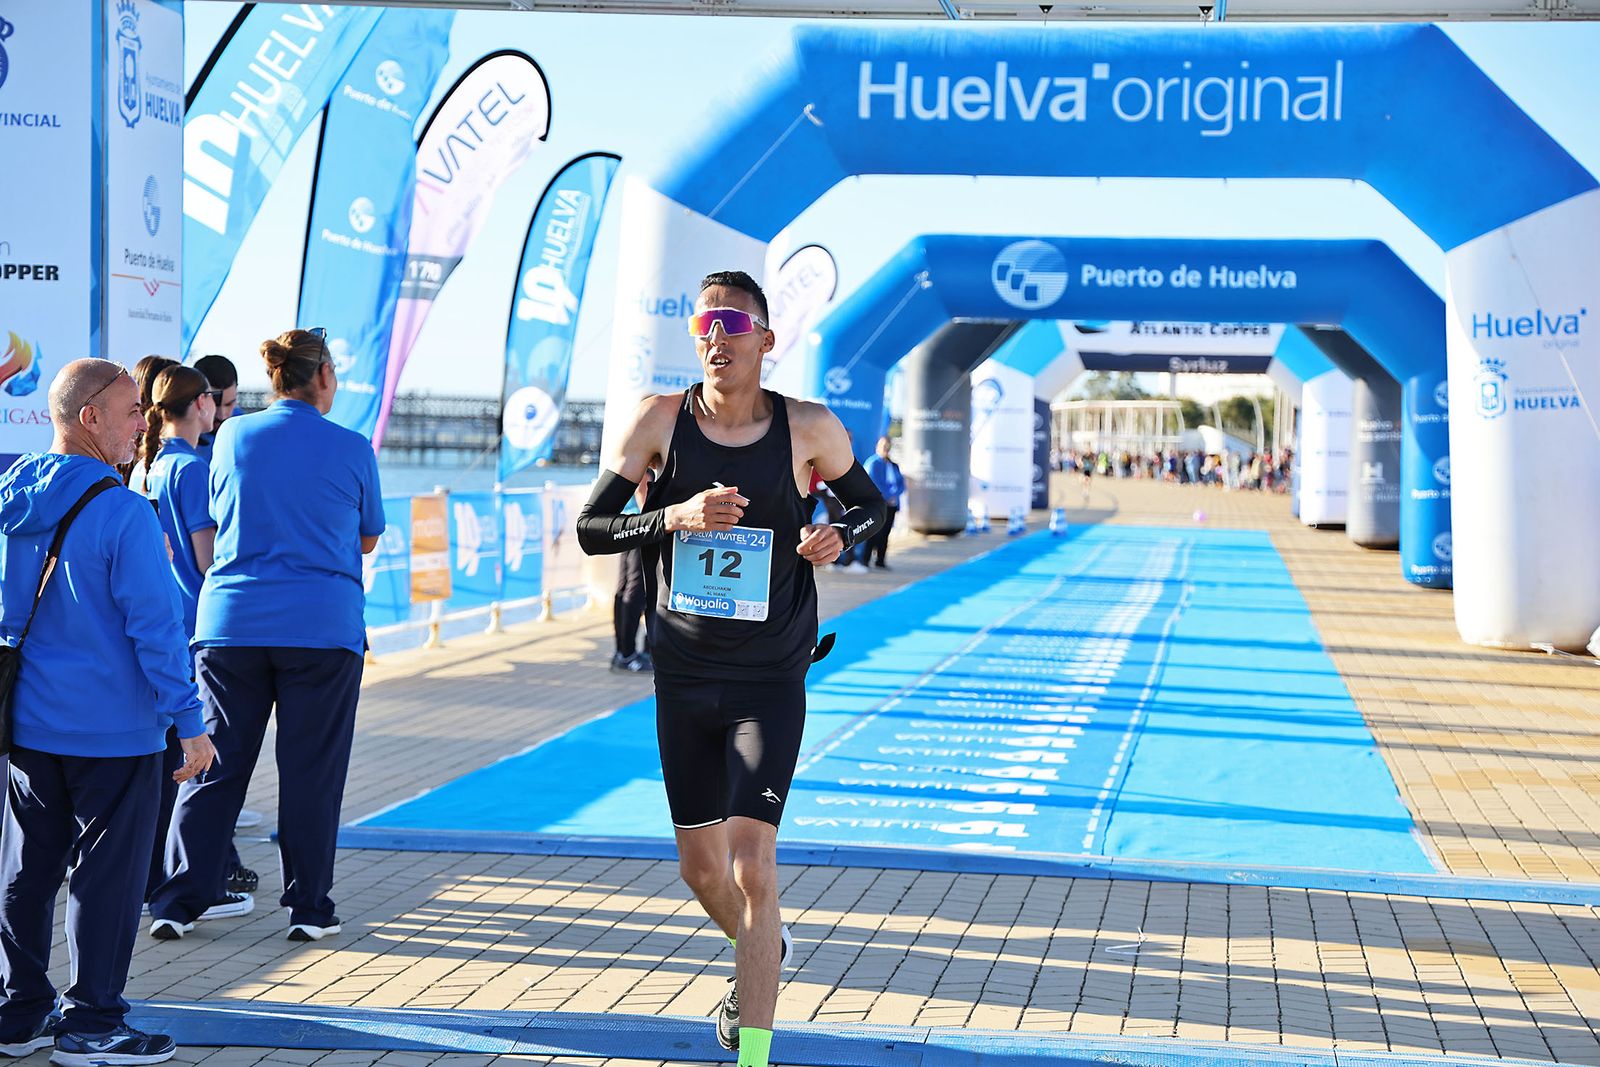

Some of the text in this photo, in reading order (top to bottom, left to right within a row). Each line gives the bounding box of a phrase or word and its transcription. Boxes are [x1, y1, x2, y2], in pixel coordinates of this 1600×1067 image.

[145, 92, 180, 127] HUELVA
[858, 59, 1344, 137] Huelva original
[541, 189, 582, 271] HUELVA
[123, 248, 147, 268] Puerto
[1080, 263, 1297, 288] Puerto de Huelva
[1472, 308, 1580, 338] Huelva
[1514, 396, 1580, 410] HUELVA
[0, 407, 52, 426] IGAS
[715, 532, 747, 543] AVATEL
[698, 548, 742, 579] 12
[685, 595, 729, 610] Wayalia
